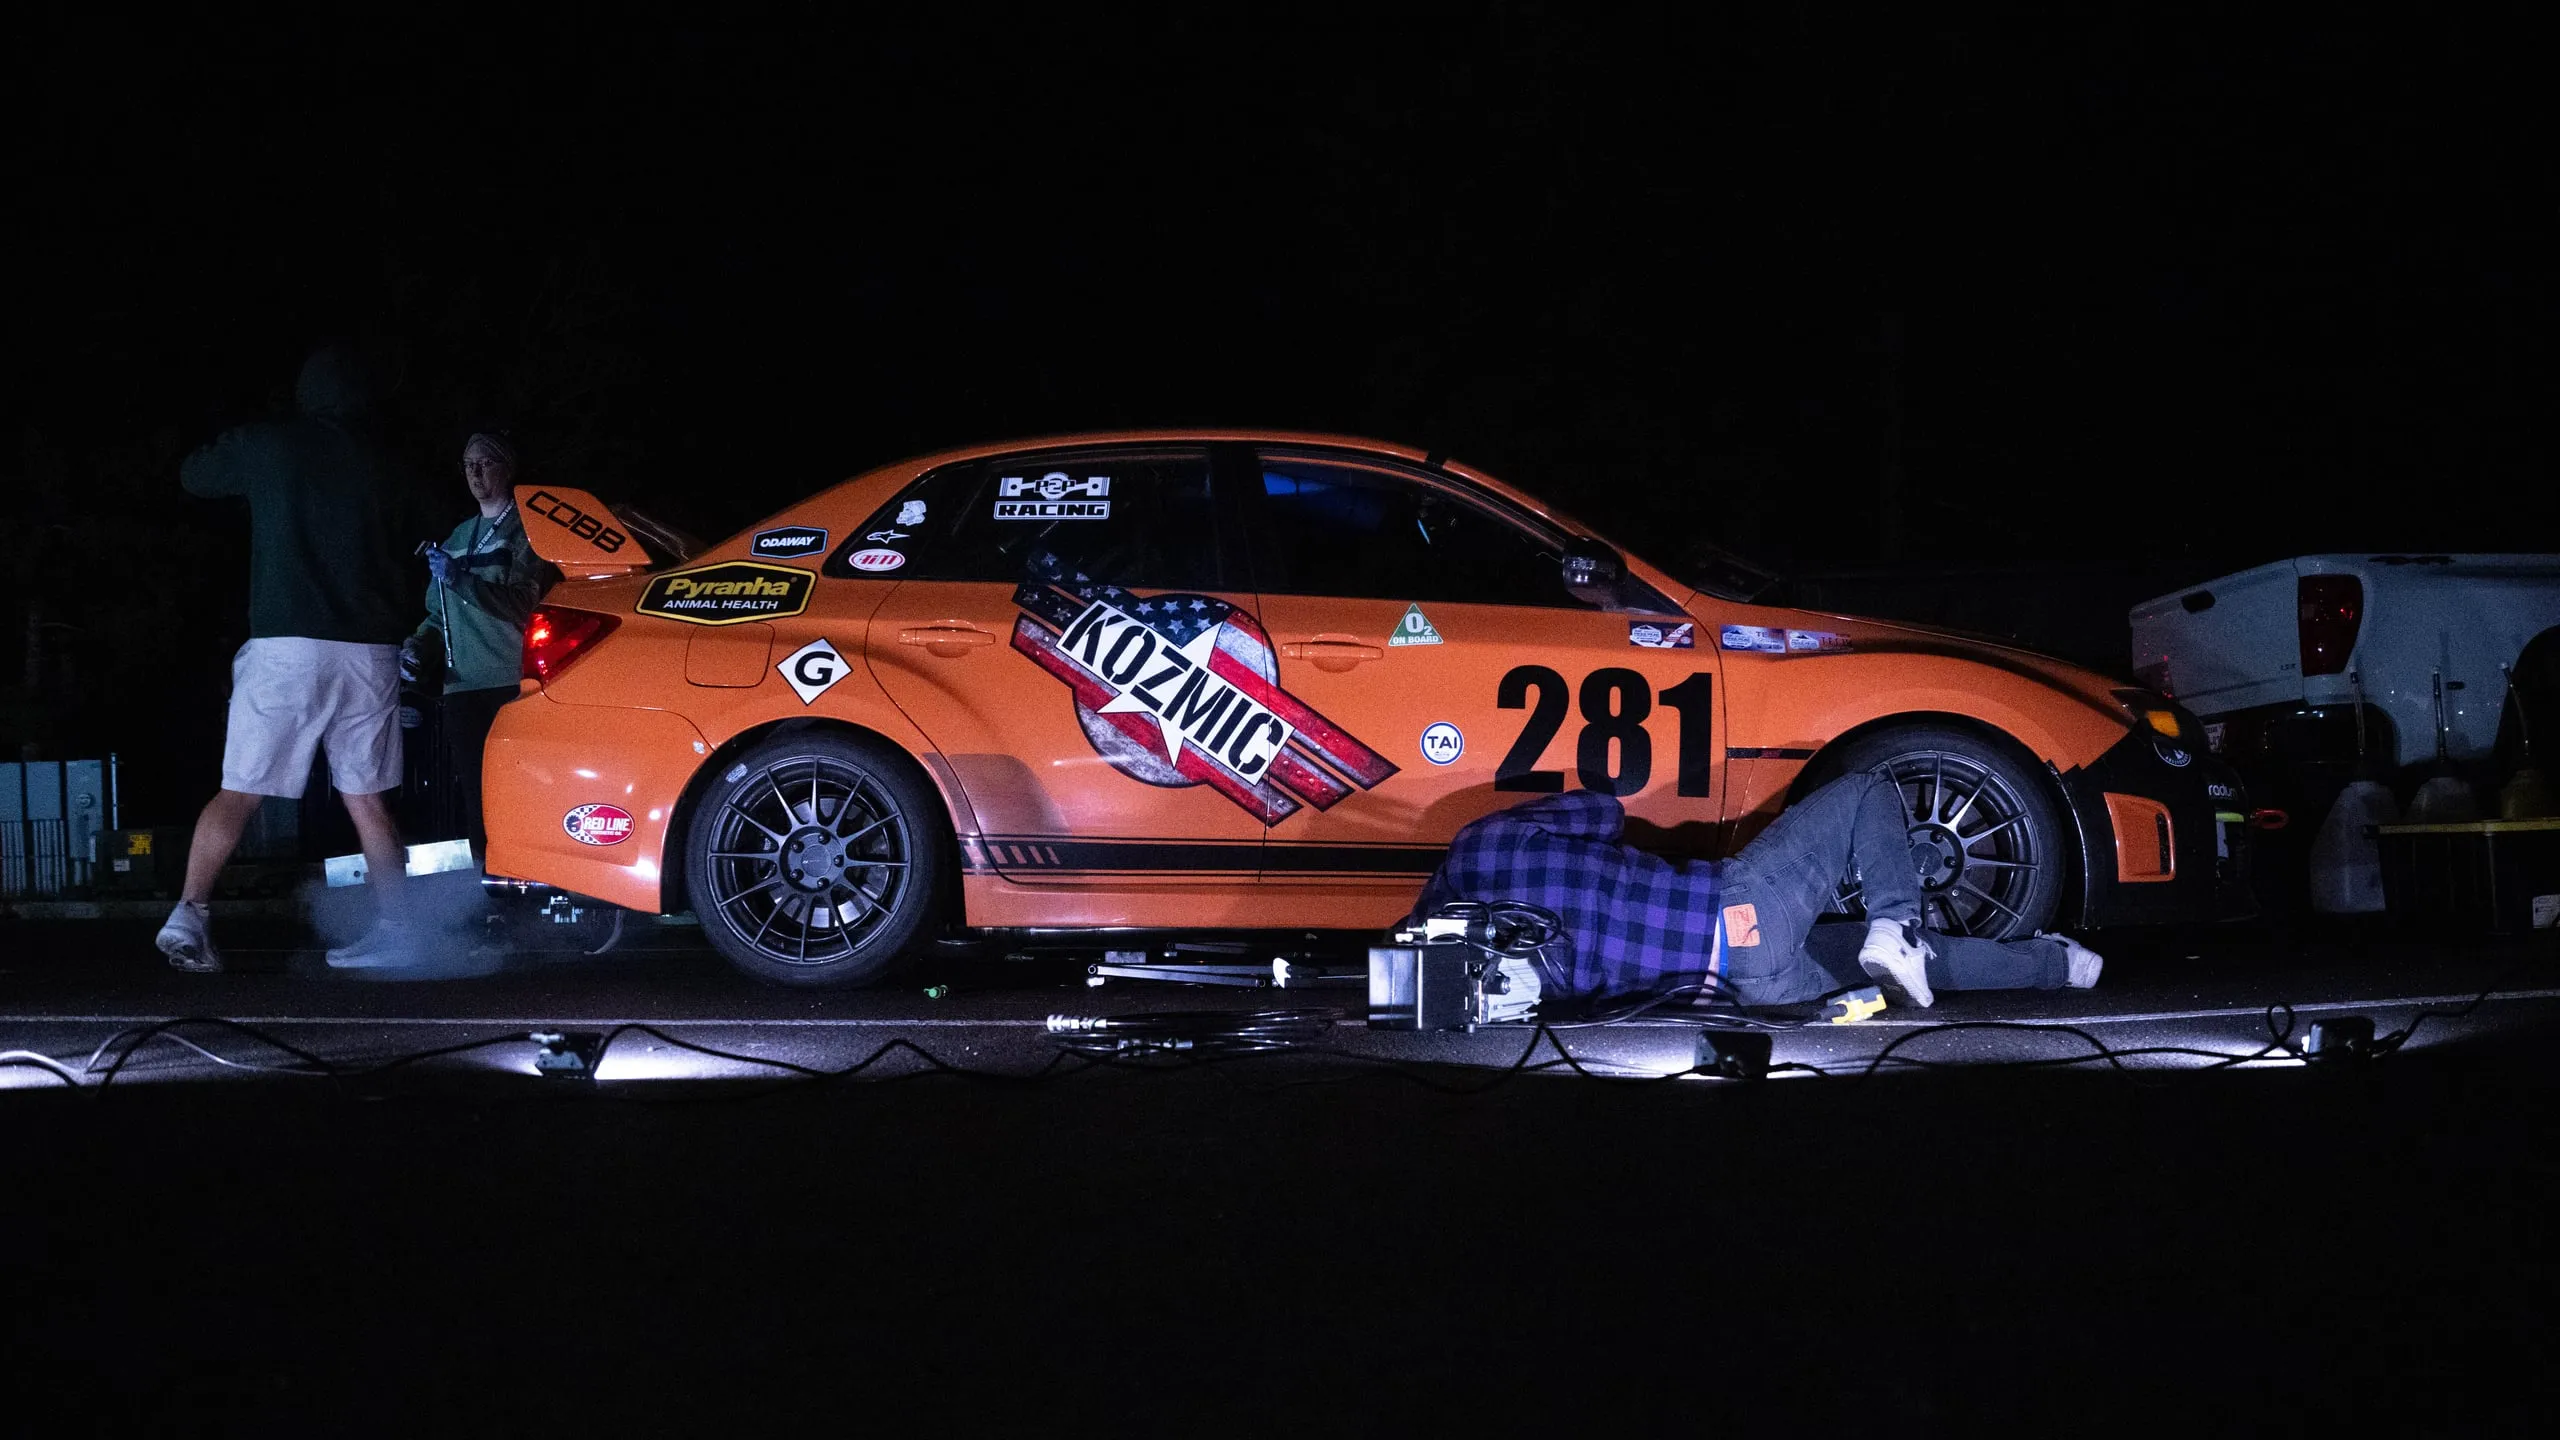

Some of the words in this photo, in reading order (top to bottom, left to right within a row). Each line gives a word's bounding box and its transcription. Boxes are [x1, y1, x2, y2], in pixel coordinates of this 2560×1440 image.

[998, 503, 1106, 517] RACING
[526, 491, 626, 553] COBB
[760, 536, 816, 548] ODAWAY
[664, 577, 791, 599] Pyranha
[663, 600, 718, 610] ANIMAL
[721, 600, 779, 610] HEALTH
[1392, 636, 1406, 644] ON
[1408, 635, 1439, 643] BOARD
[794, 651, 837, 687] G
[1061, 602, 1285, 775] KOZMIC
[1494, 665, 1712, 798] 281
[1427, 736, 1457, 749] TAI
[583, 817, 605, 830] RED
[606, 818, 631, 831] LINE
